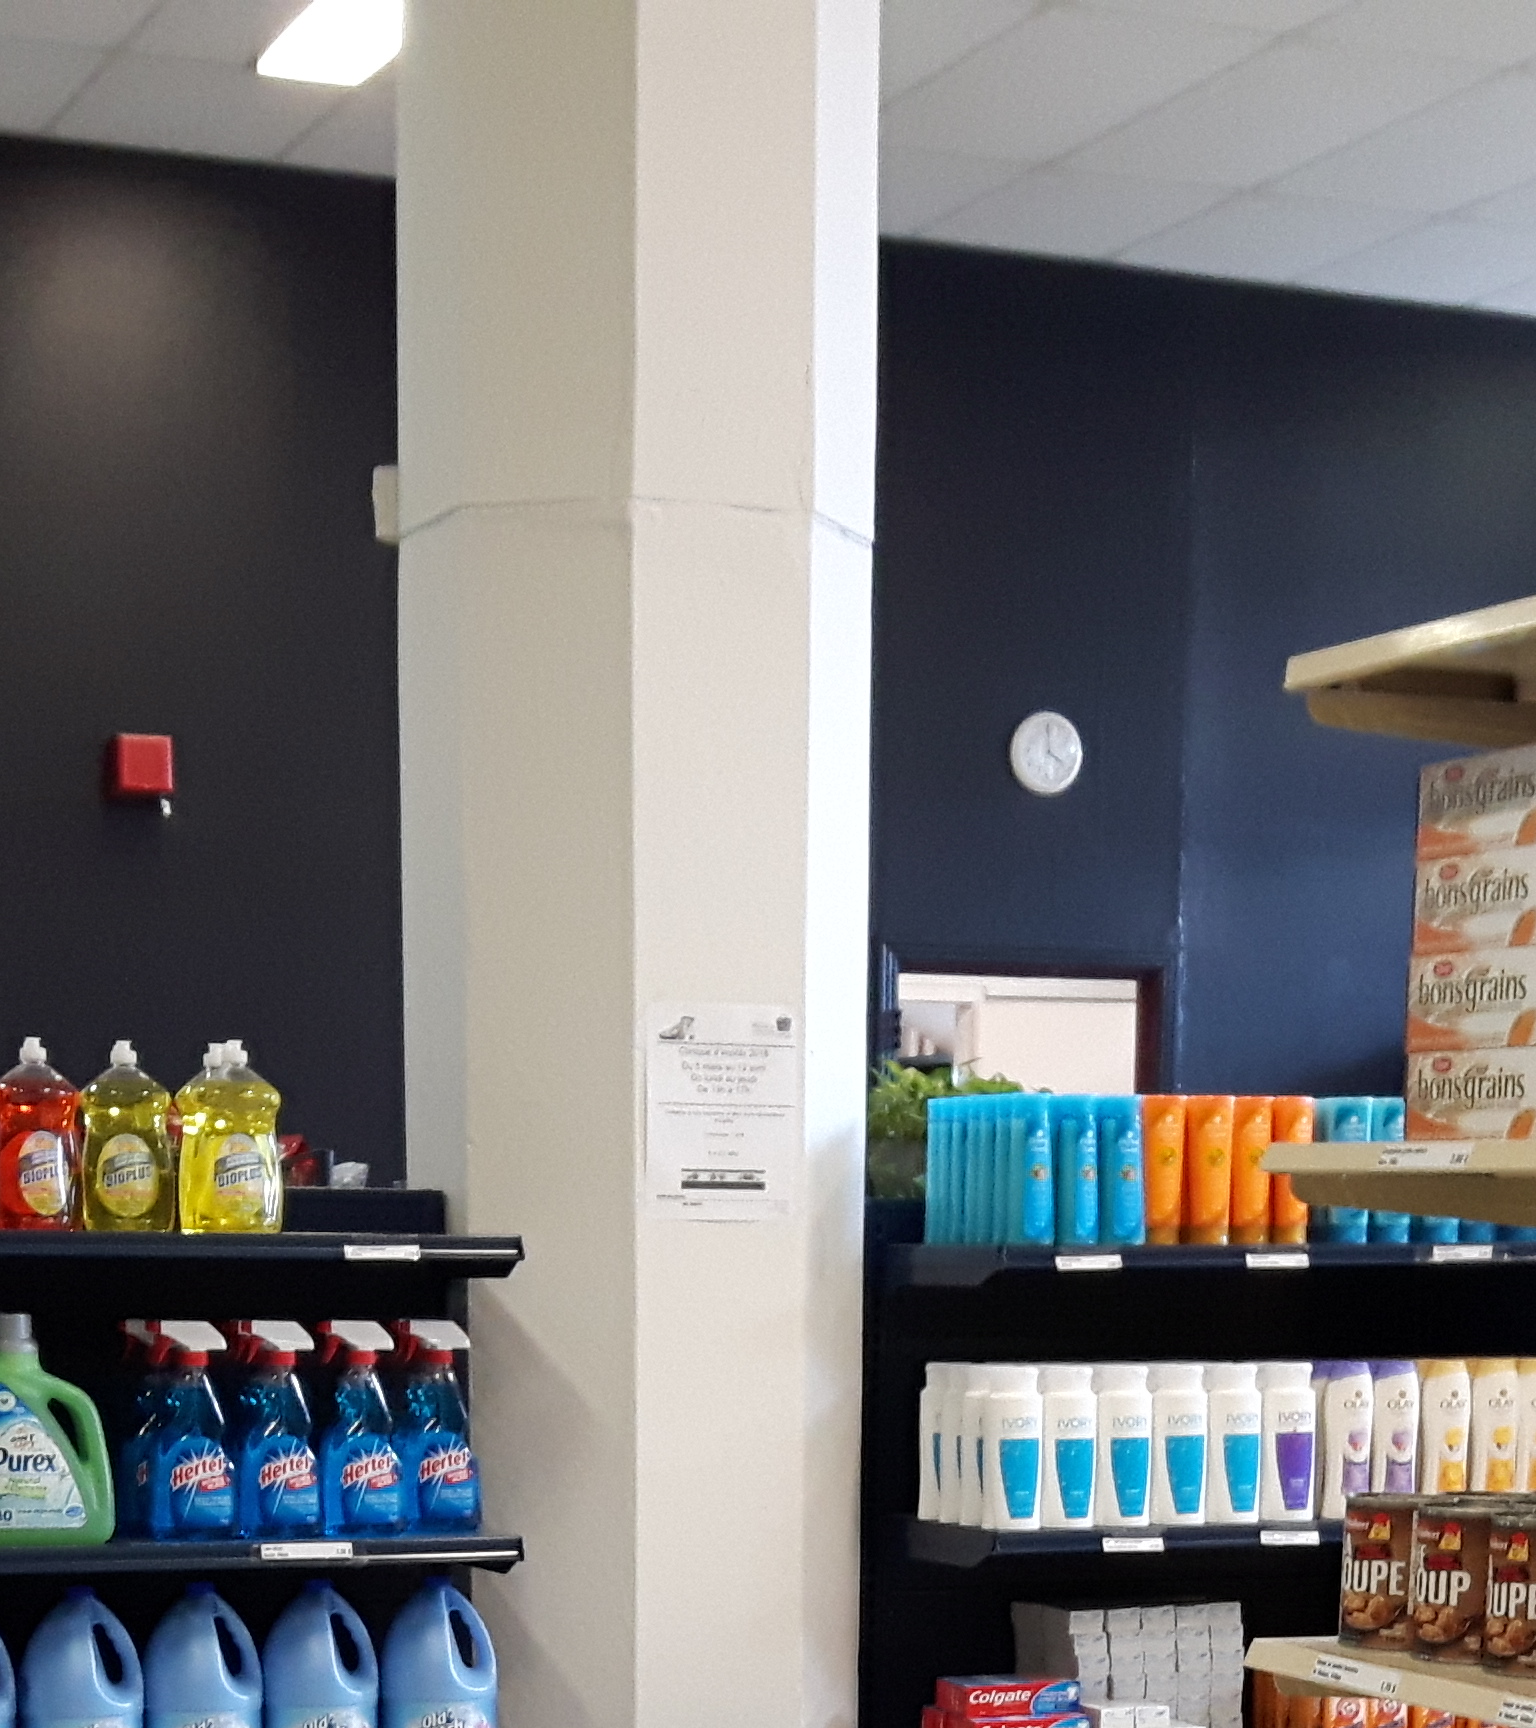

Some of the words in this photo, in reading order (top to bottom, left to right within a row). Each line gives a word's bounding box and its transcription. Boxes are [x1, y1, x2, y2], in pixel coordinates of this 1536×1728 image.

[173, 1458, 225, 1487] Hertel
[260, 1457, 310, 1487] Hertel
[342, 1456, 393, 1486] Hertel
[419, 1452, 467, 1482] Hertel
[1343, 1555, 1407, 1597] OUPE
[969, 1689, 1032, 1707] Colgate
[421, 1709, 451, 1728] Old
